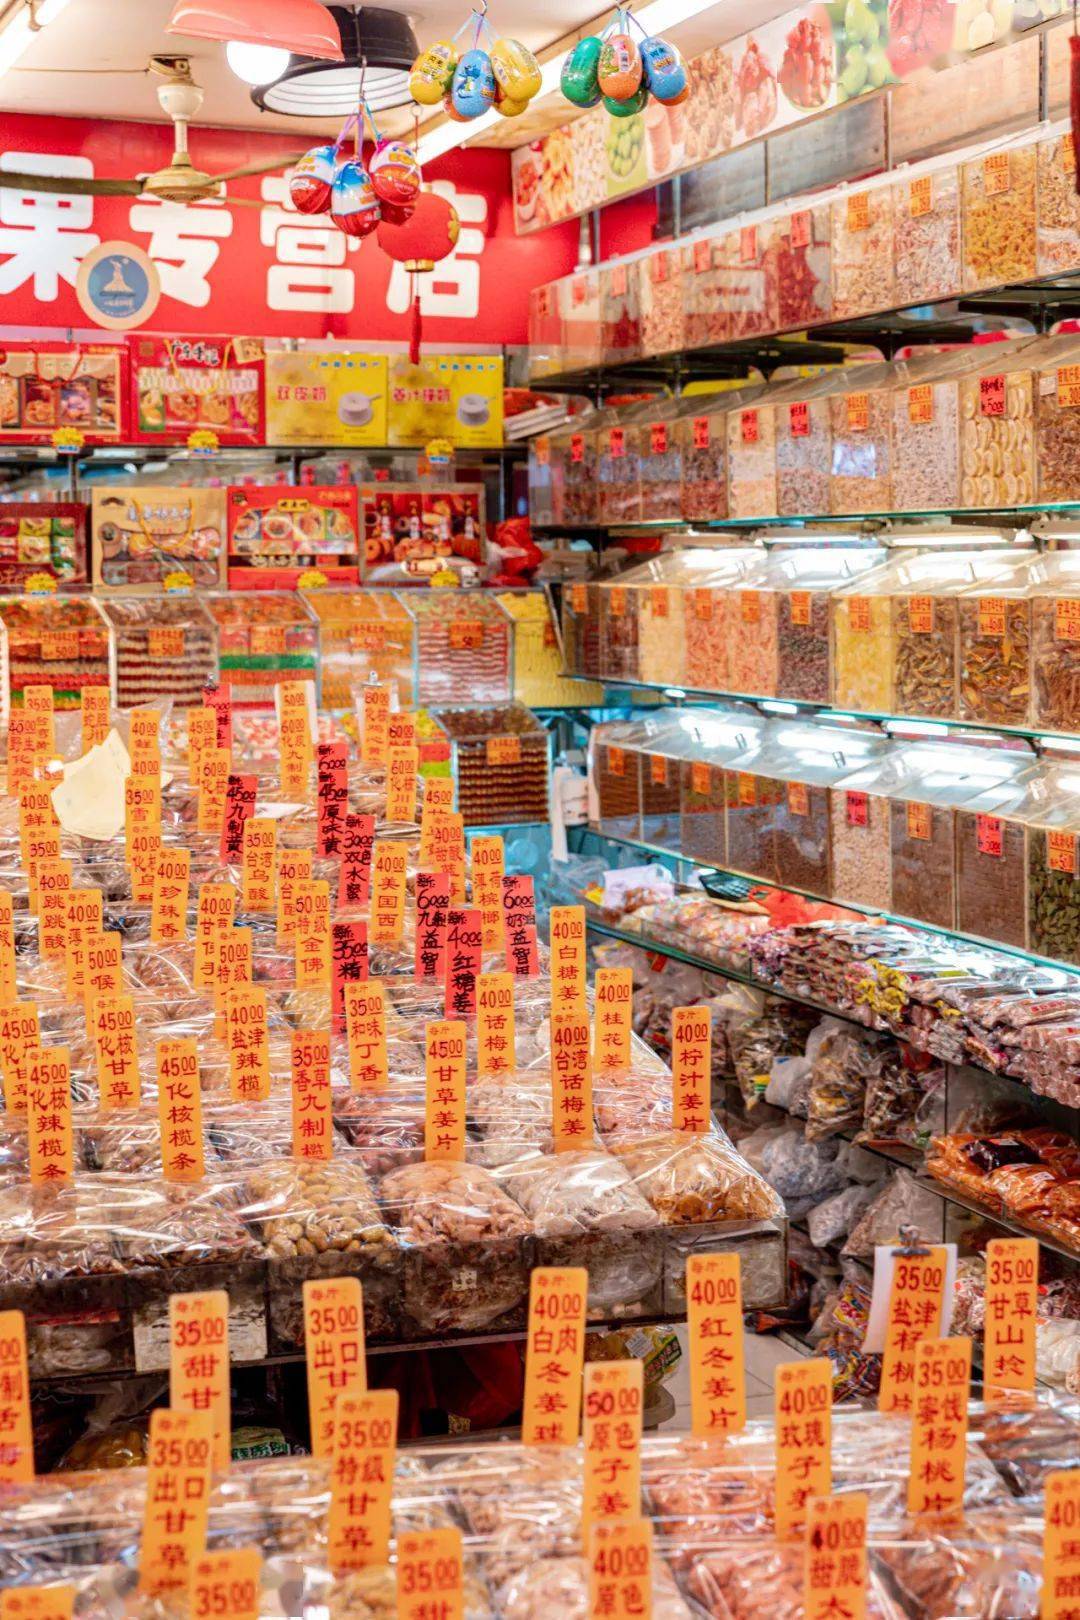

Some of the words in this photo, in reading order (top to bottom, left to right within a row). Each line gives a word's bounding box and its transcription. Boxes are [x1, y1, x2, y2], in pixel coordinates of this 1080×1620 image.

[344, 850, 372, 866] 双色
[158, 886, 182, 938] 珍珠香
[231, 1027, 265, 1050] 盐津
[484, 1013, 511, 1072] 话梅姜
[600, 1012, 625, 1068] 桂花姜
[294, 1069, 329, 1092] 香草
[355, 1042, 382, 1082] 丁香
[555, 1050, 588, 1071] 台湾
[432, 1065, 459, 1151] 甘草姜片
[559, 1073, 586, 1137] 话梅姜
[678, 1049, 705, 1132] 柠汁姜片
[165, 1082, 197, 1171] 化核榄条
[990, 1292, 1033, 1322] 甘草
[313, 1339, 359, 1370] 出口
[533, 1328, 579, 1356] 白肉
[699, 1317, 738, 1430] 红冬姜片
[153, 1473, 205, 1503] 出口
